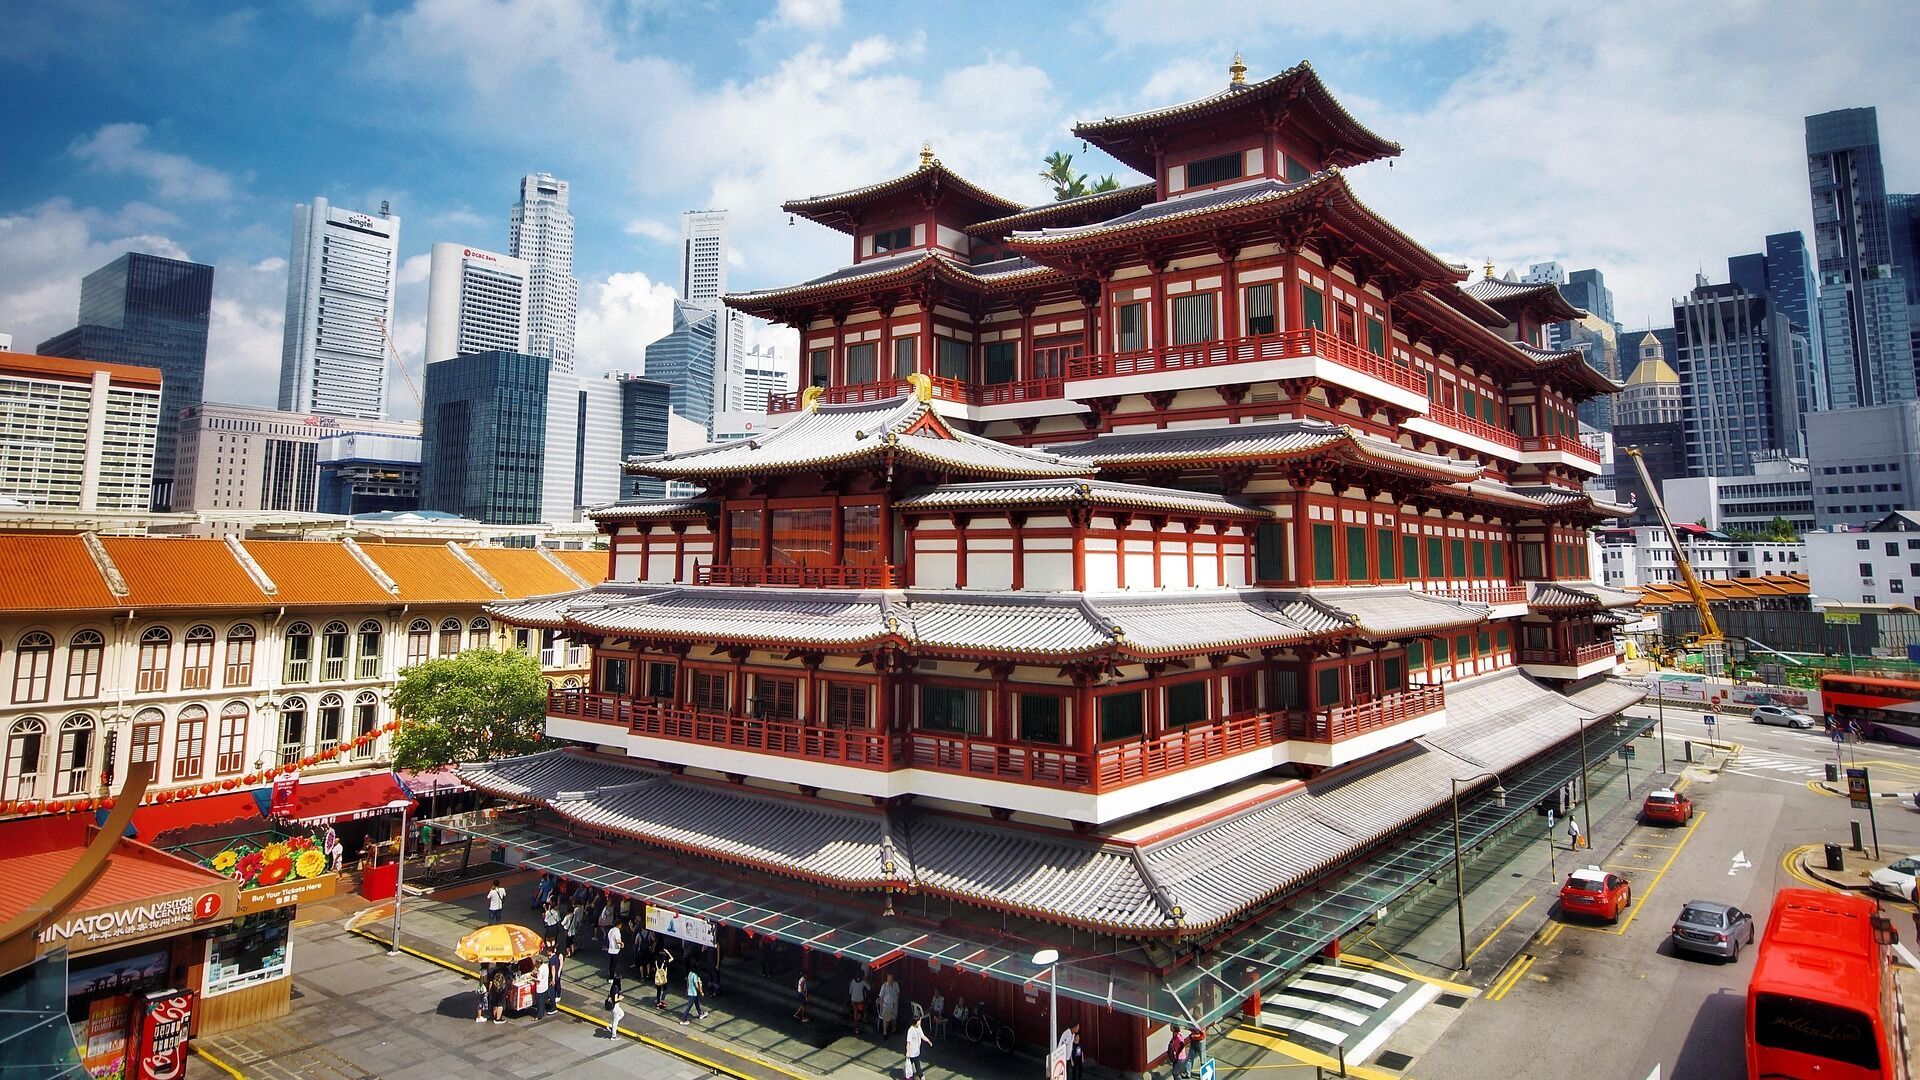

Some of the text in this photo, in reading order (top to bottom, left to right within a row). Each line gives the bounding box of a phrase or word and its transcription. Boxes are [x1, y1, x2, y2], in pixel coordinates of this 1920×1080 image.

[348, 216, 374, 228] Singtel
[471, 251, 485, 260] OCBC
[251, 883, 322, 902] Buy Your Tickets Here
[154, 905, 193, 919] CENTRE
[38, 896, 193, 943] INATOWN VISITOR
